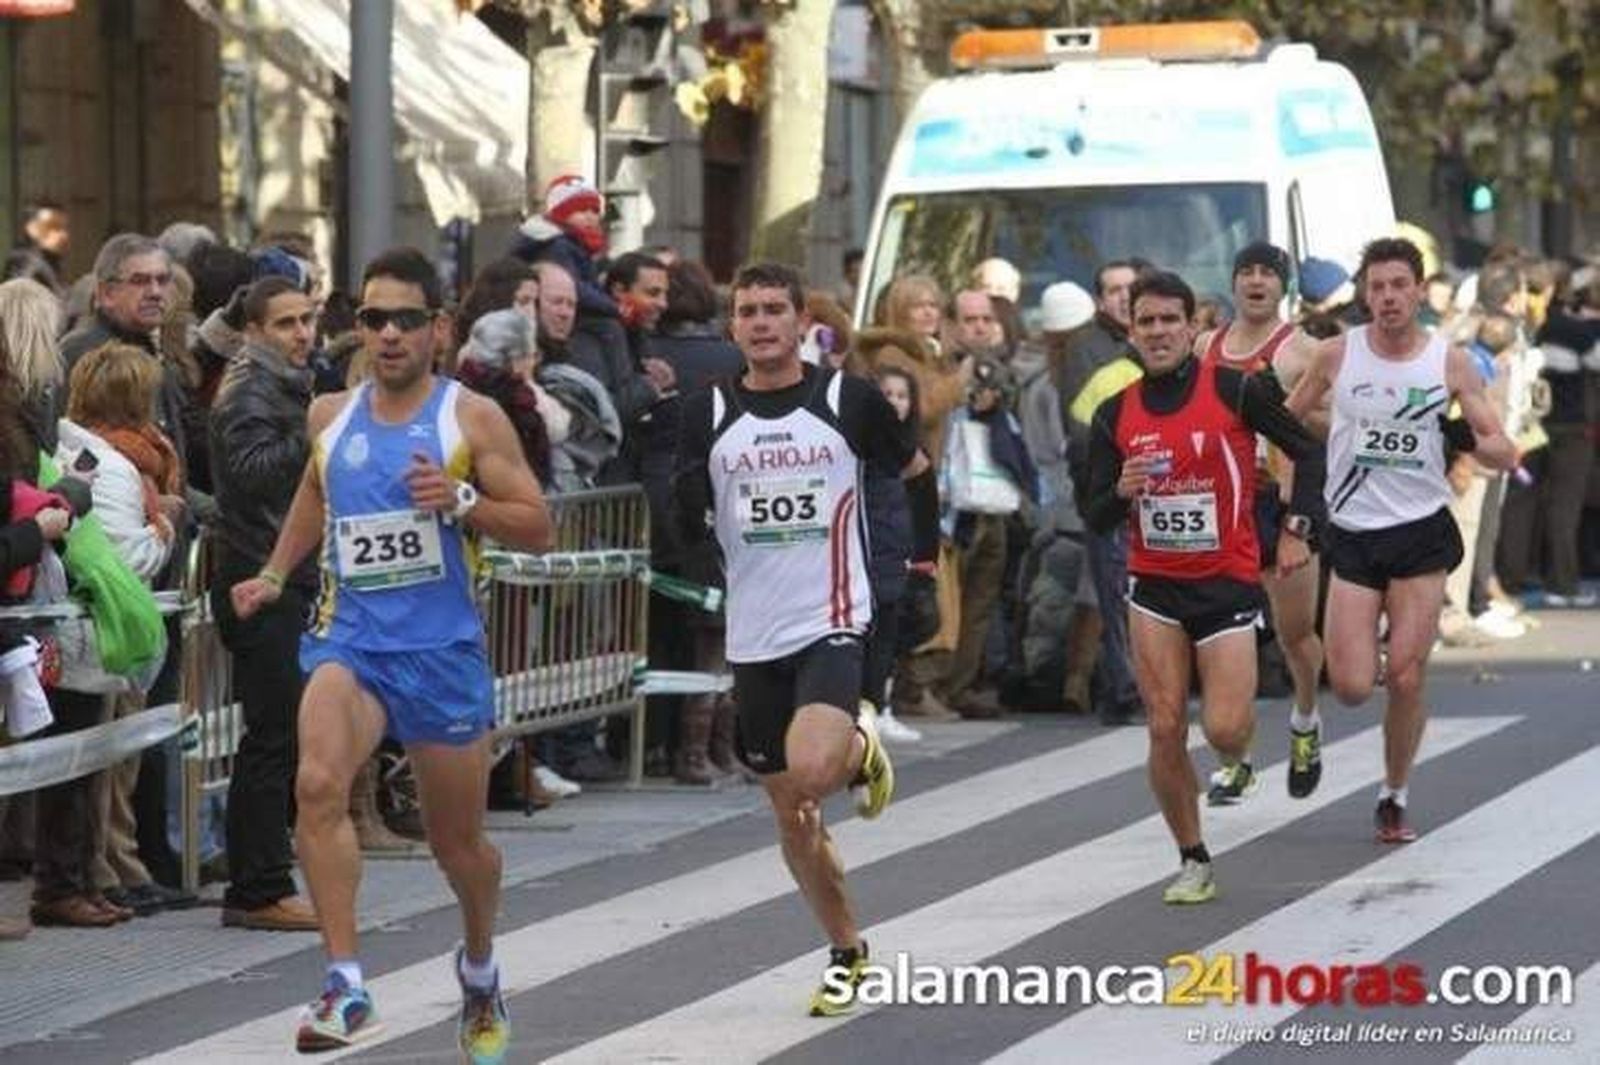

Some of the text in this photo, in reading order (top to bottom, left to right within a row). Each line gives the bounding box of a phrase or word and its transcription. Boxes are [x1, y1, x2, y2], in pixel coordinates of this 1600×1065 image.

[1366, 430, 1419, 453] 269
[722, 445, 833, 475] LA RIOJA
[751, 493, 817, 523] 503
[1152, 510, 1206, 533] 653
[353, 530, 423, 566] 238
